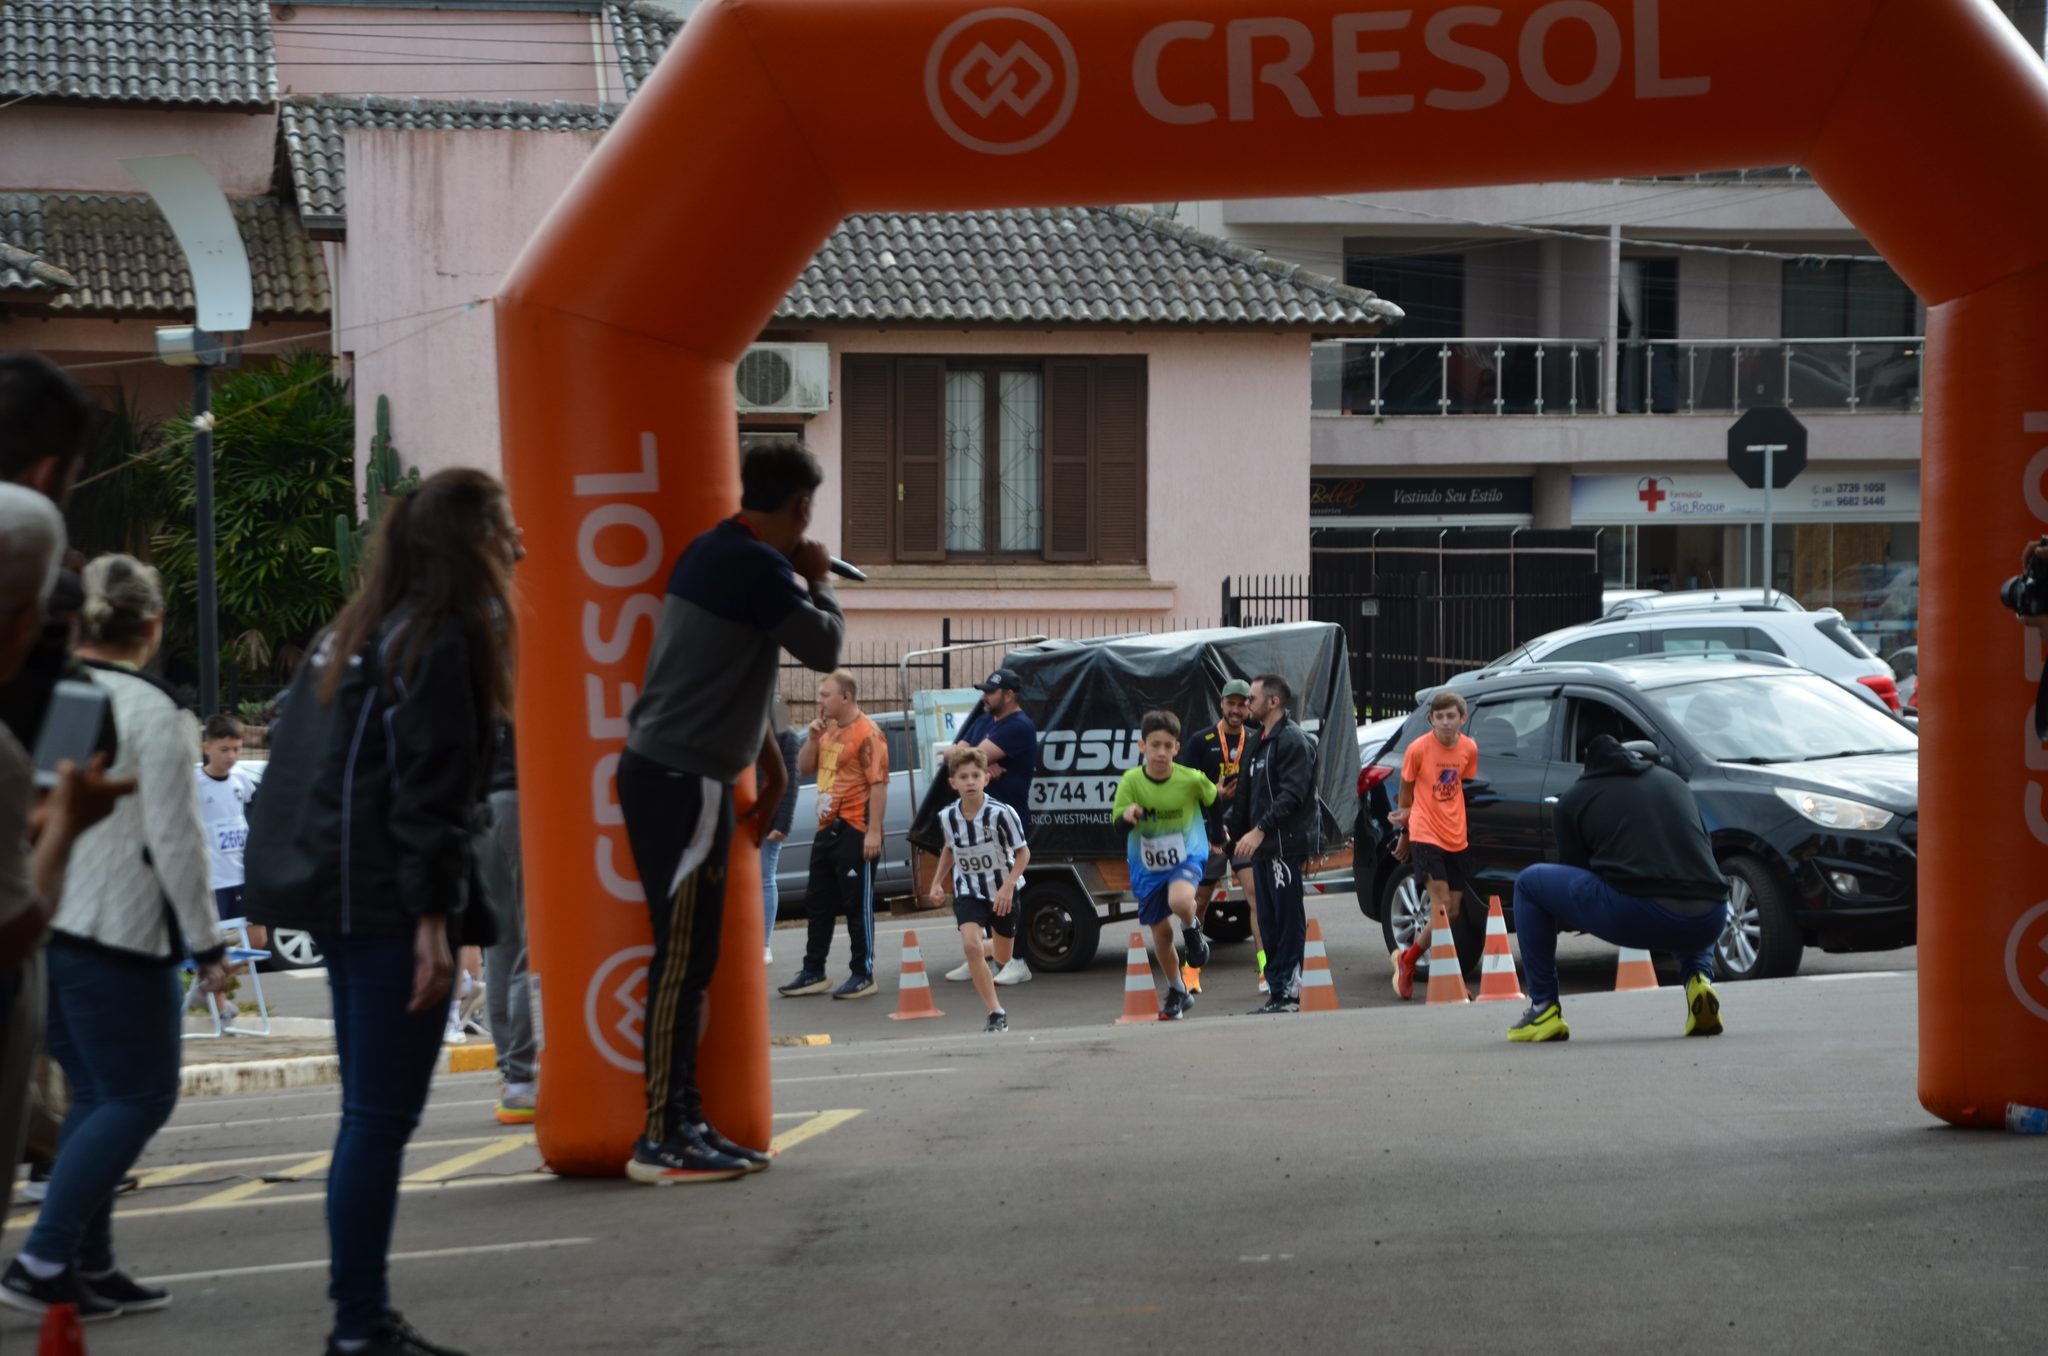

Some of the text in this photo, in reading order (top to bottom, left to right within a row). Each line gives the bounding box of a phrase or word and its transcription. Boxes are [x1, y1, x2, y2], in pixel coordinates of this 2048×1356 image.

[1131, 0, 1711, 125] CRESOL
[1394, 488, 1503, 503] Vestindo Seu Estilo
[1670, 490, 1702, 498] Farmácia
[1670, 501, 1689, 512] São
[1692, 502, 1725, 512] Roque
[1033, 781, 1087, 803] 3744
[1029, 814, 1052, 824] RICO
[960, 854, 993, 872] 990
[1145, 848, 1180, 867] 968
